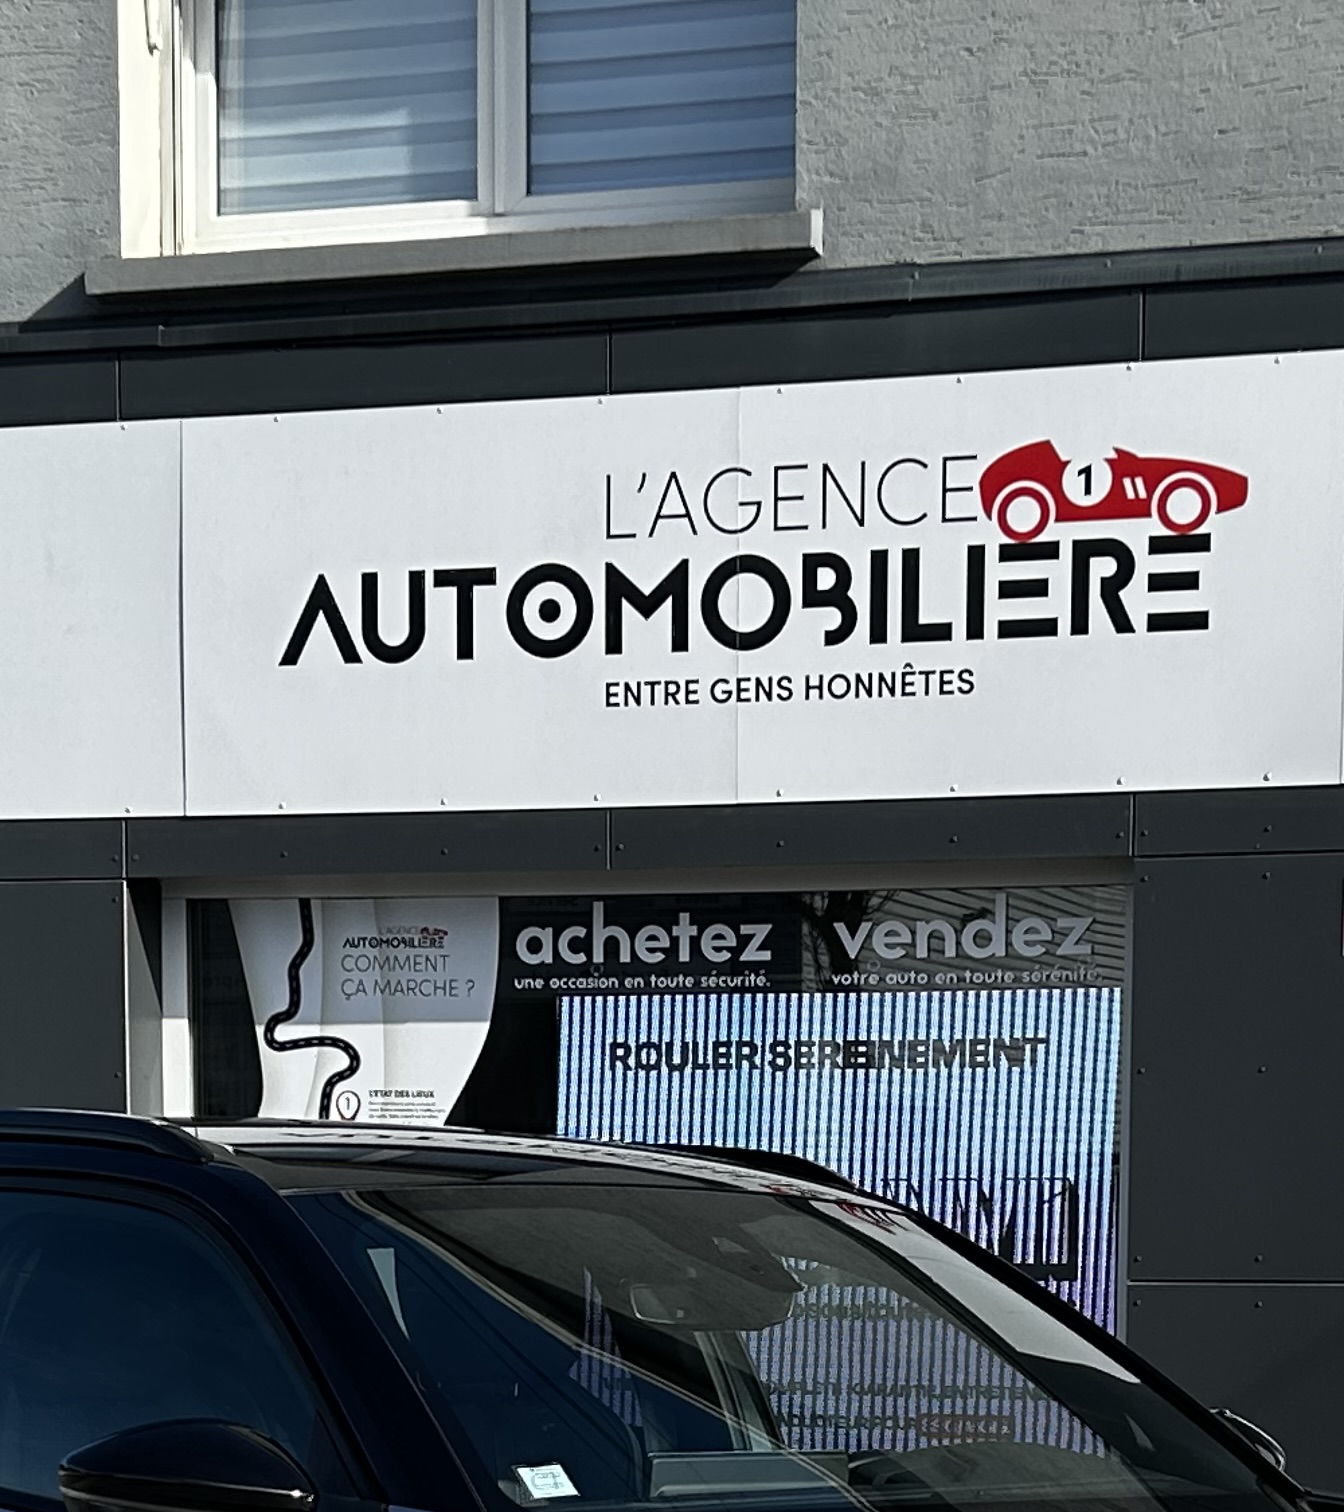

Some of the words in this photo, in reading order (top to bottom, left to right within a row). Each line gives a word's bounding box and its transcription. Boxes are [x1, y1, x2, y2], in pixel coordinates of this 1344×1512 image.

[605, 454, 979, 540] L'AGENCE
[604, 678, 701, 708] ENTRE
[709, 675, 794, 705] GENS
[804, 662, 976, 701] HONNÊTES
[515, 900, 773, 965] achetez
[832, 892, 1096, 960] vendez
[340, 953, 451, 973] COMMENT
[514, 977, 545, 989] une
[549, 971, 619, 989] occasion
[624, 976, 644, 989] en
[650, 973, 694, 989] toute
[700, 969, 772, 988] sécurité.
[831, 970, 880, 985] votre
[885, 969, 928, 985] auto
[934, 971, 958, 985] en
[964, 968, 1016, 984] toute
[340, 978, 368, 1001] ÇA
[373, 979, 459, 998] MARCHE
[609, 1040, 760, 1073] ROULER
